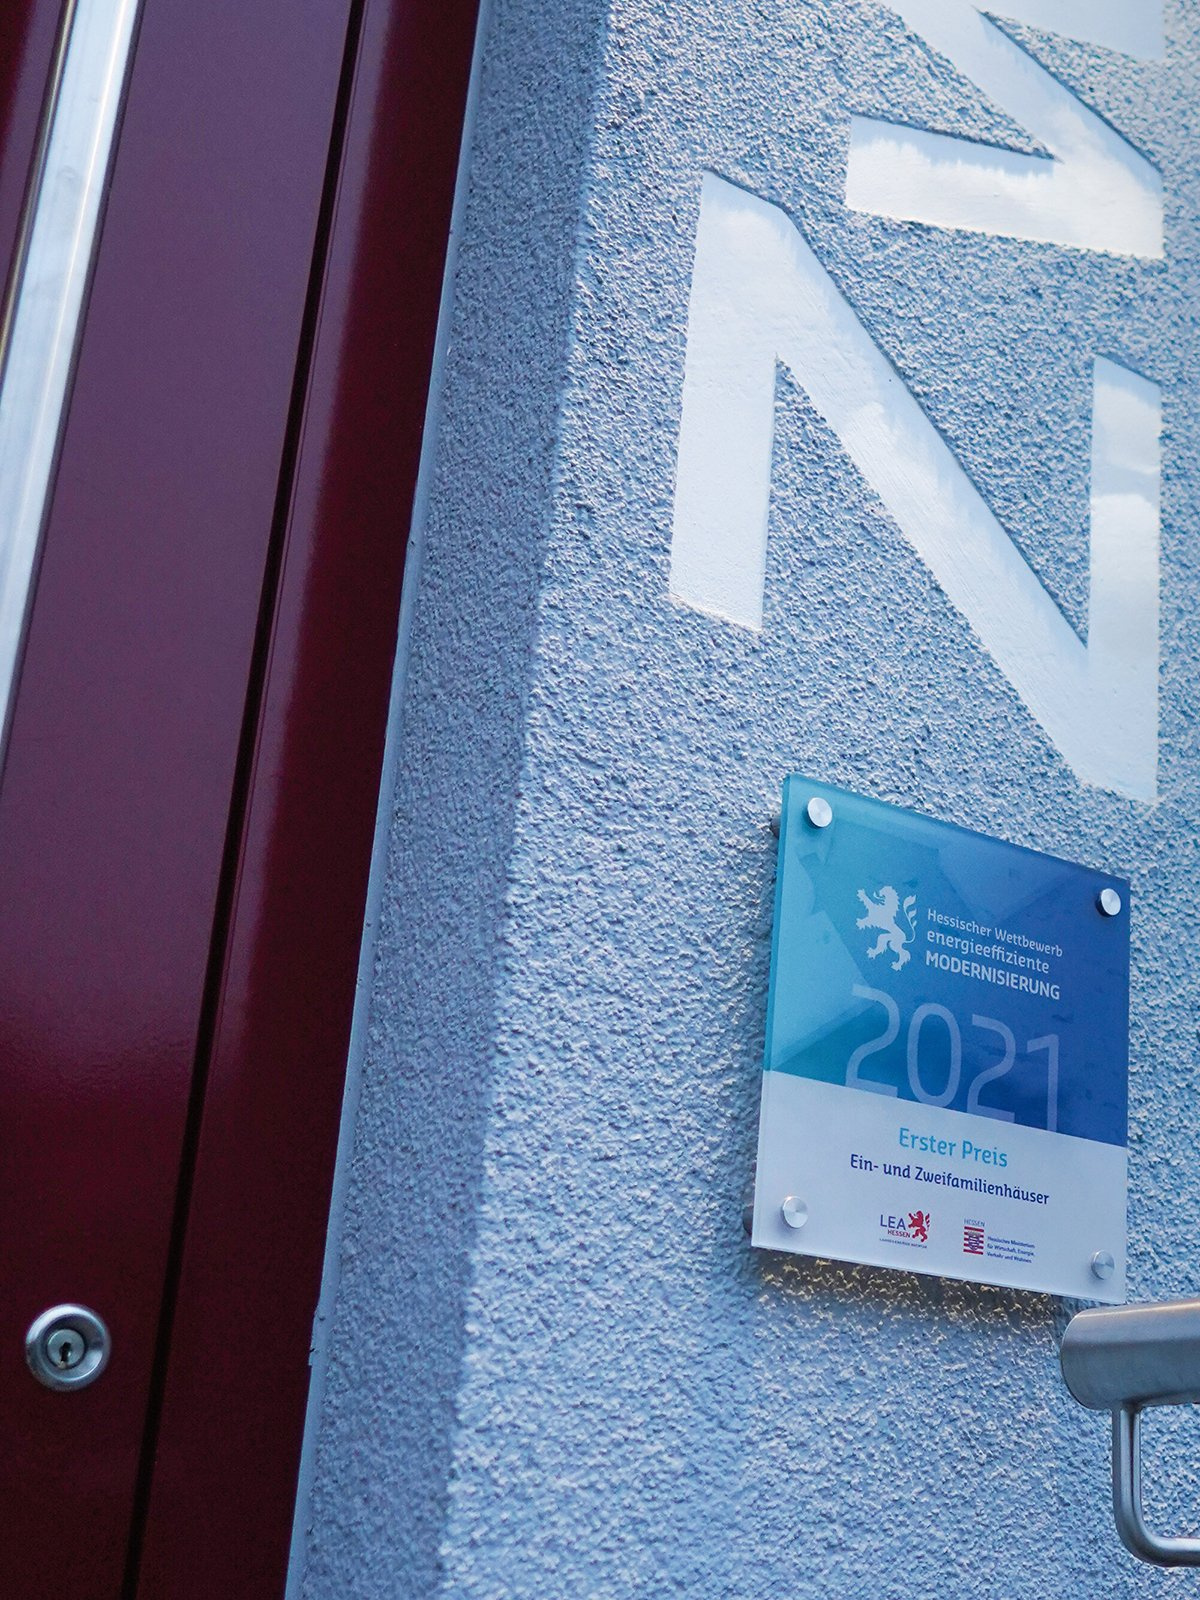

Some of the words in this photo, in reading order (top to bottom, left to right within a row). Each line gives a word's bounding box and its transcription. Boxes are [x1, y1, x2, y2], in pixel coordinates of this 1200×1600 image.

[926, 930, 1050, 974] energieeffiziente
[927, 908, 992, 938] Hessischer
[994, 927, 1063, 958] Wettbewerb
[925, 950, 1061, 1000] MODERNISIERUNG
[845, 983, 1059, 1133] 2021
[899, 1127, 957, 1156] Erster
[962, 1140, 1008, 1168] Preis
[850, 1153, 879, 1172] Ein-
[883, 1163, 911, 1179] und
[914, 1166, 1050, 1205] Zweifamilienhäuser
[880, 1214, 906, 1231] LEA
[887, 1229, 911, 1238] HESSEN
